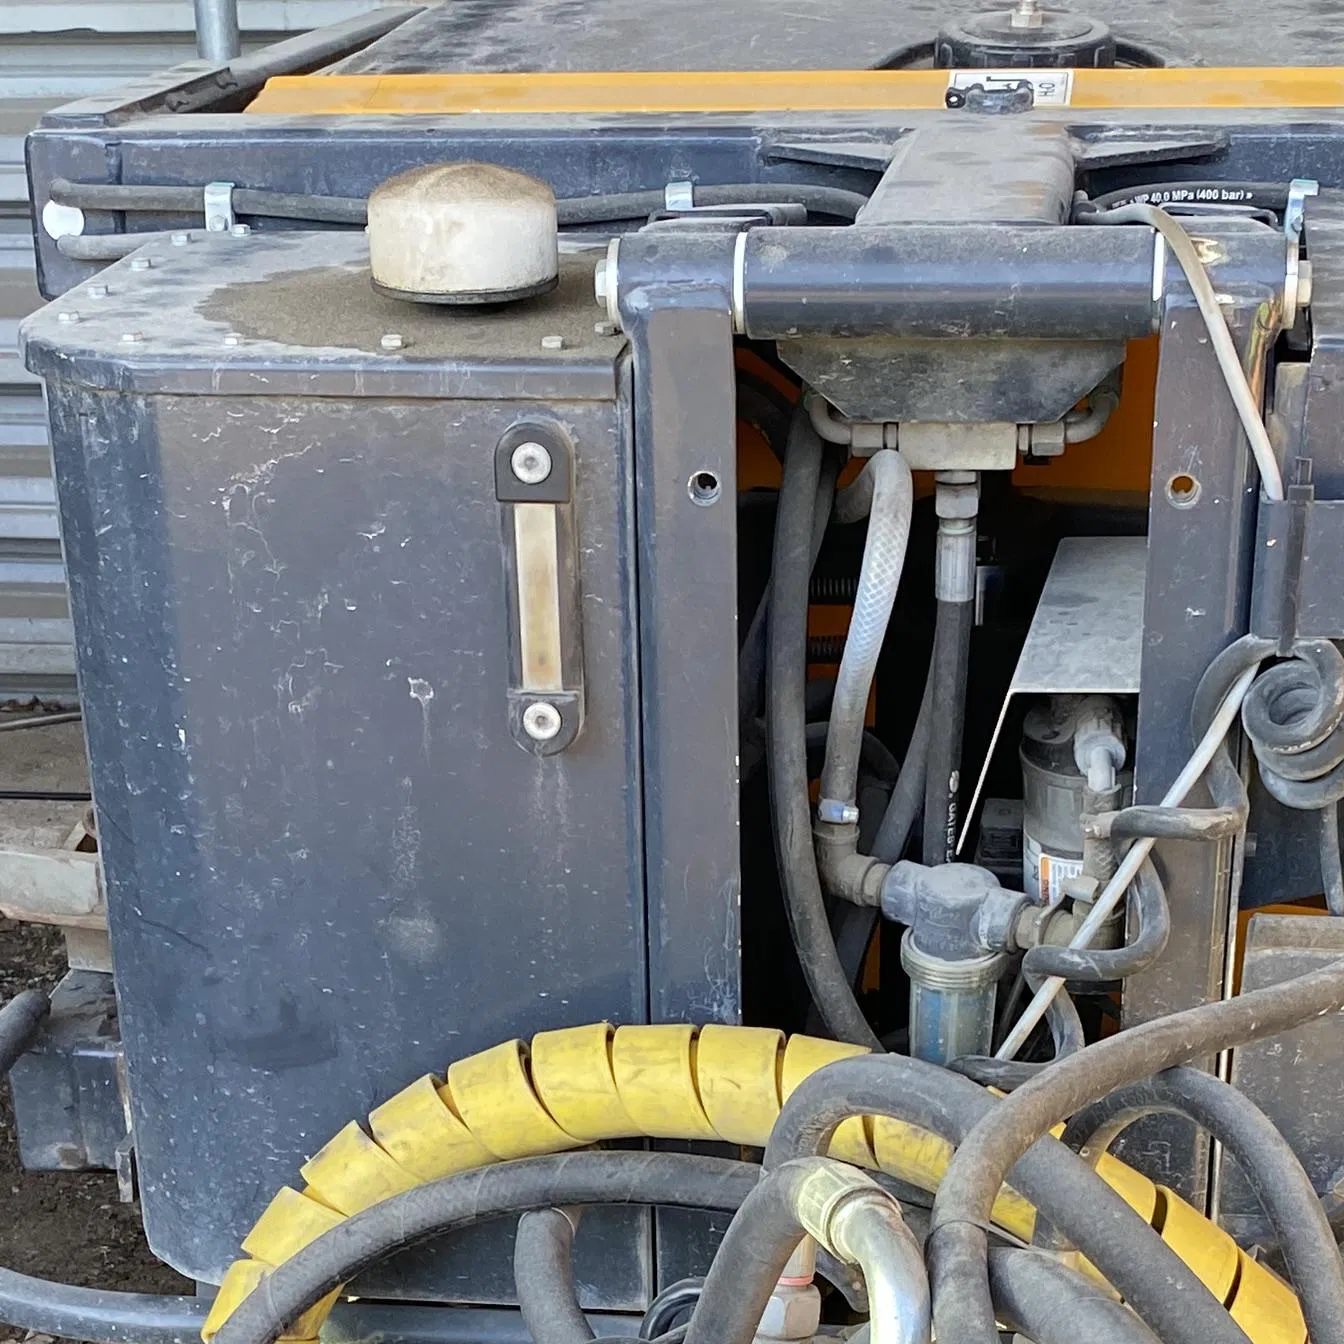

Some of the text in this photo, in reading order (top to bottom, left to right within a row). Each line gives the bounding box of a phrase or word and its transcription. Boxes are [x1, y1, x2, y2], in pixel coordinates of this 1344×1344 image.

[1150, 190, 1170, 203] 40.0
[1171, 189, 1194, 201] MPa
[1196, 188, 1219, 200] (400
[1221, 189, 1244, 200] bar)
